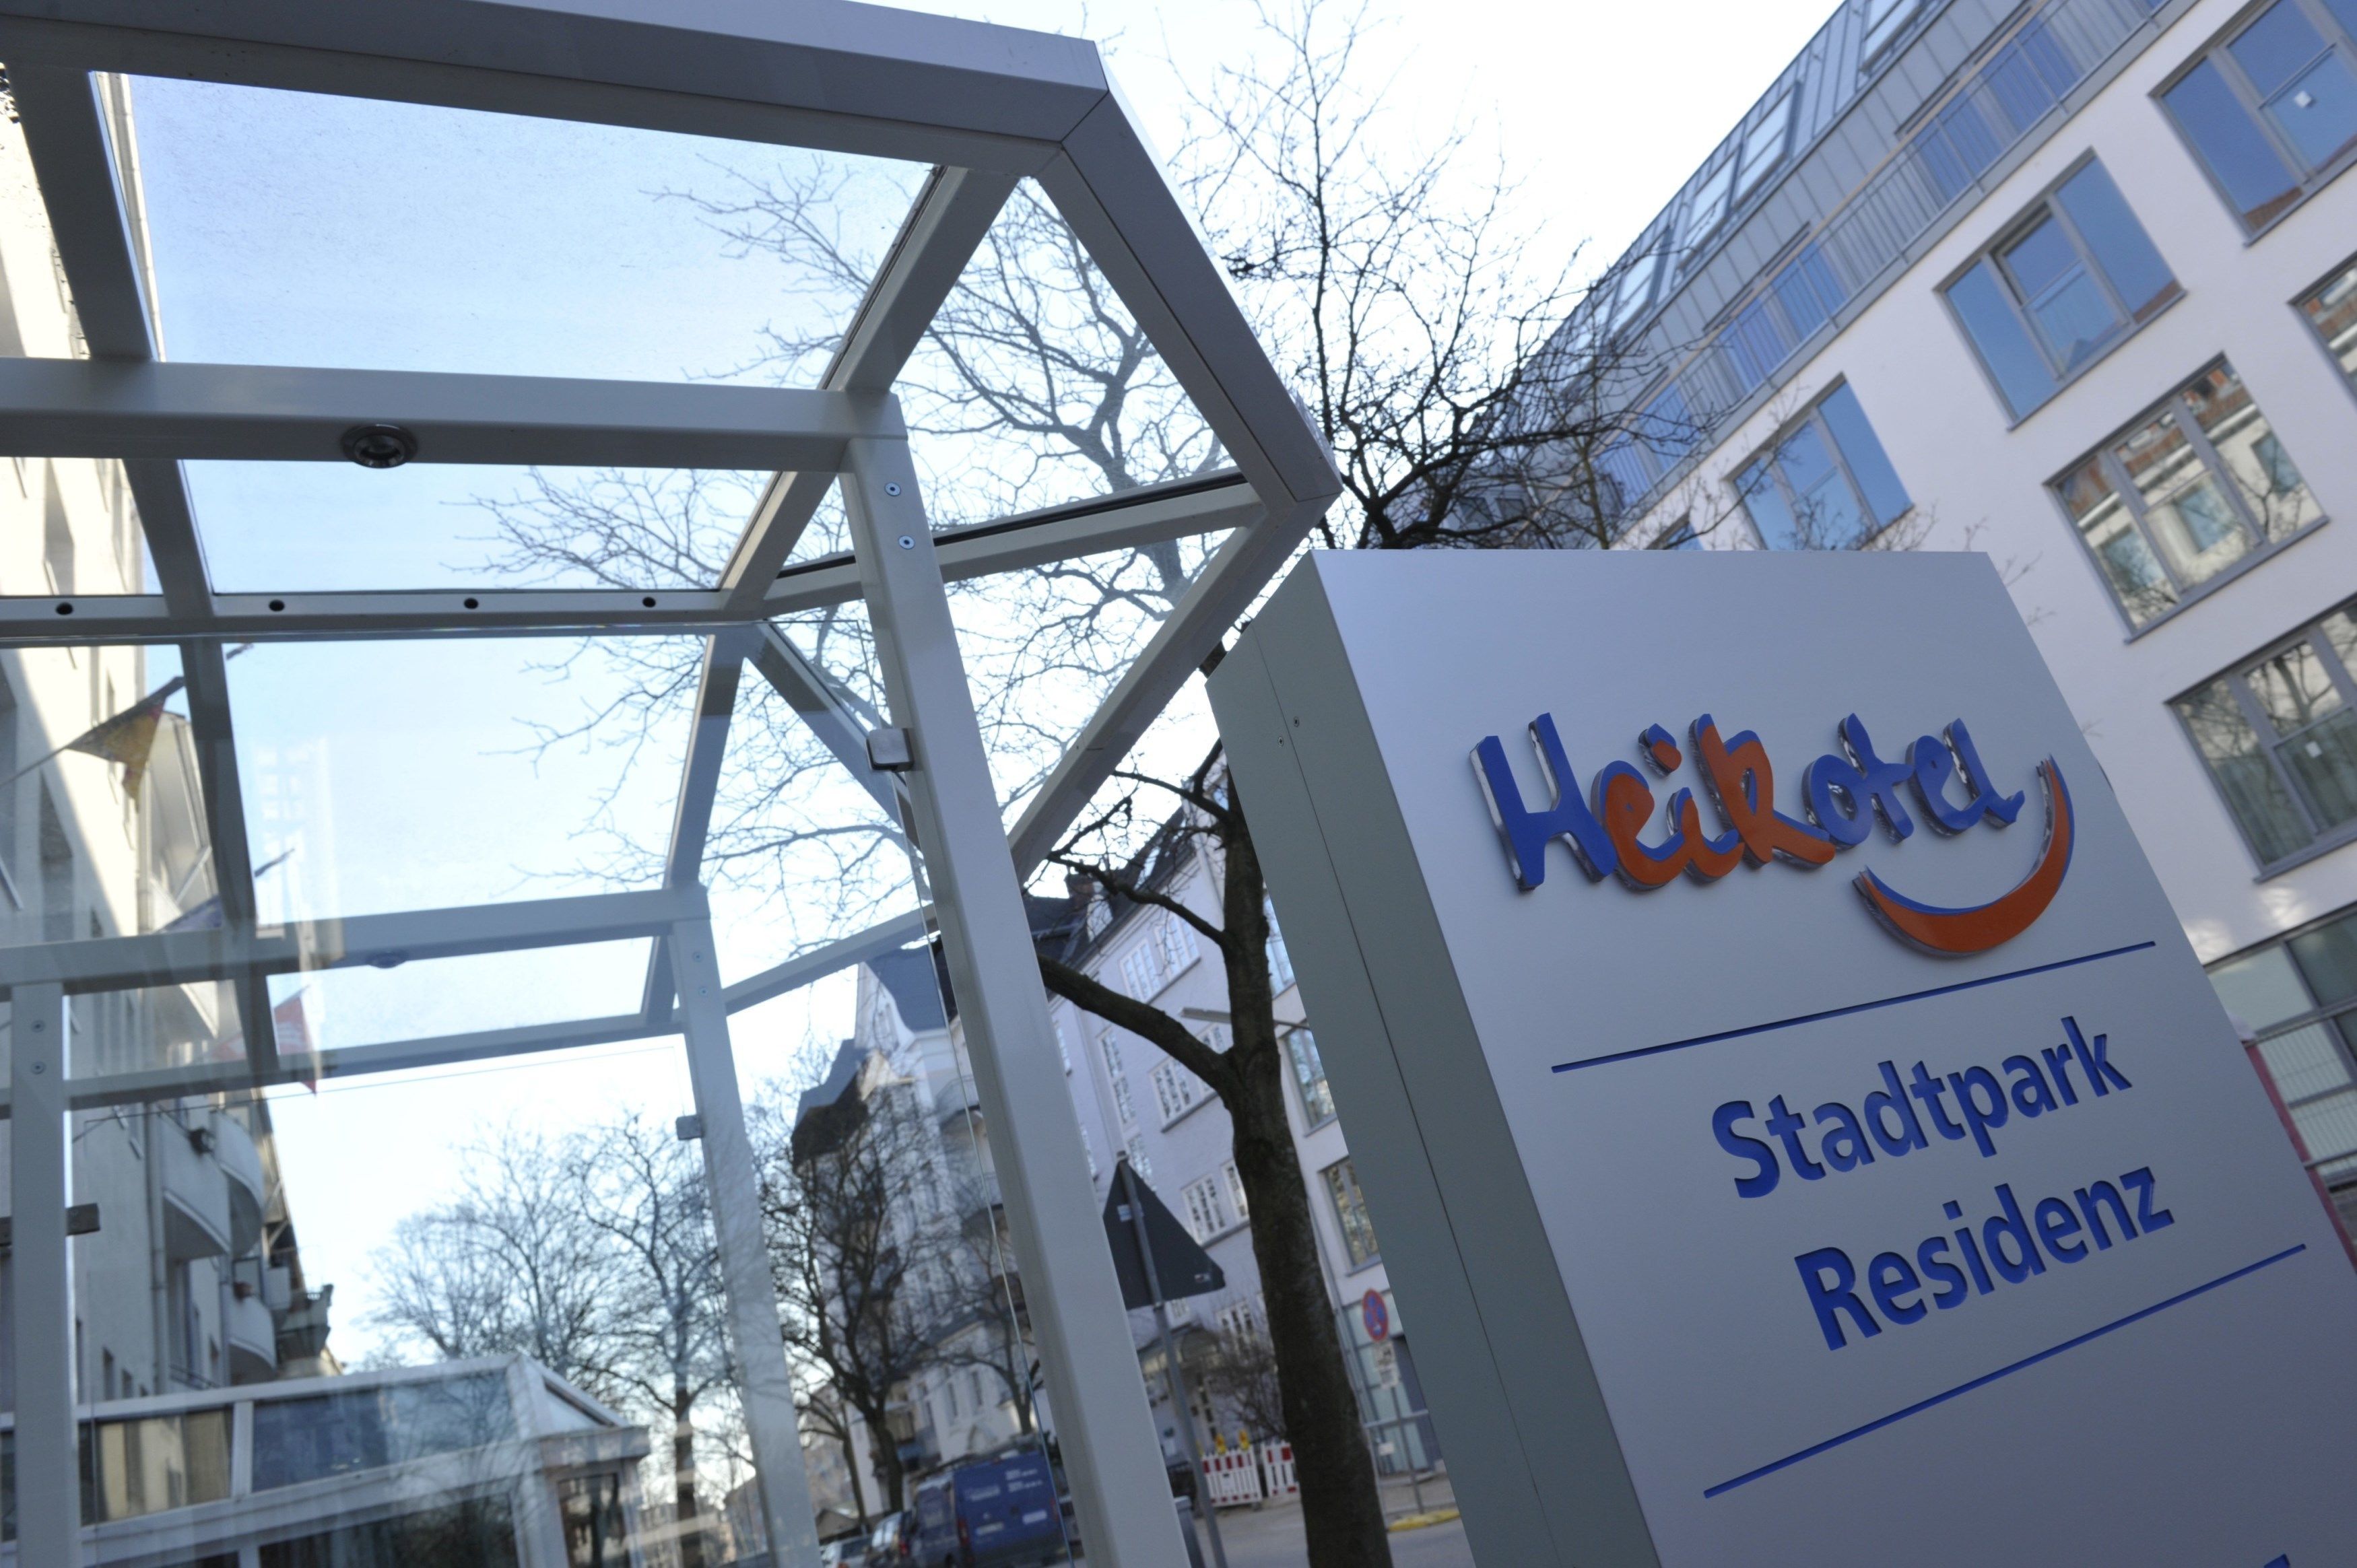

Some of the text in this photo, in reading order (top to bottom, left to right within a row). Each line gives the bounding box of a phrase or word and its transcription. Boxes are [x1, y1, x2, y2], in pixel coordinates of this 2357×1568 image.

[1470, 712, 2025, 893] Heikotel
[1711, 1016, 2132, 1198] Stadtpark
[1794, 1166, 2175, 1351] Residenz
